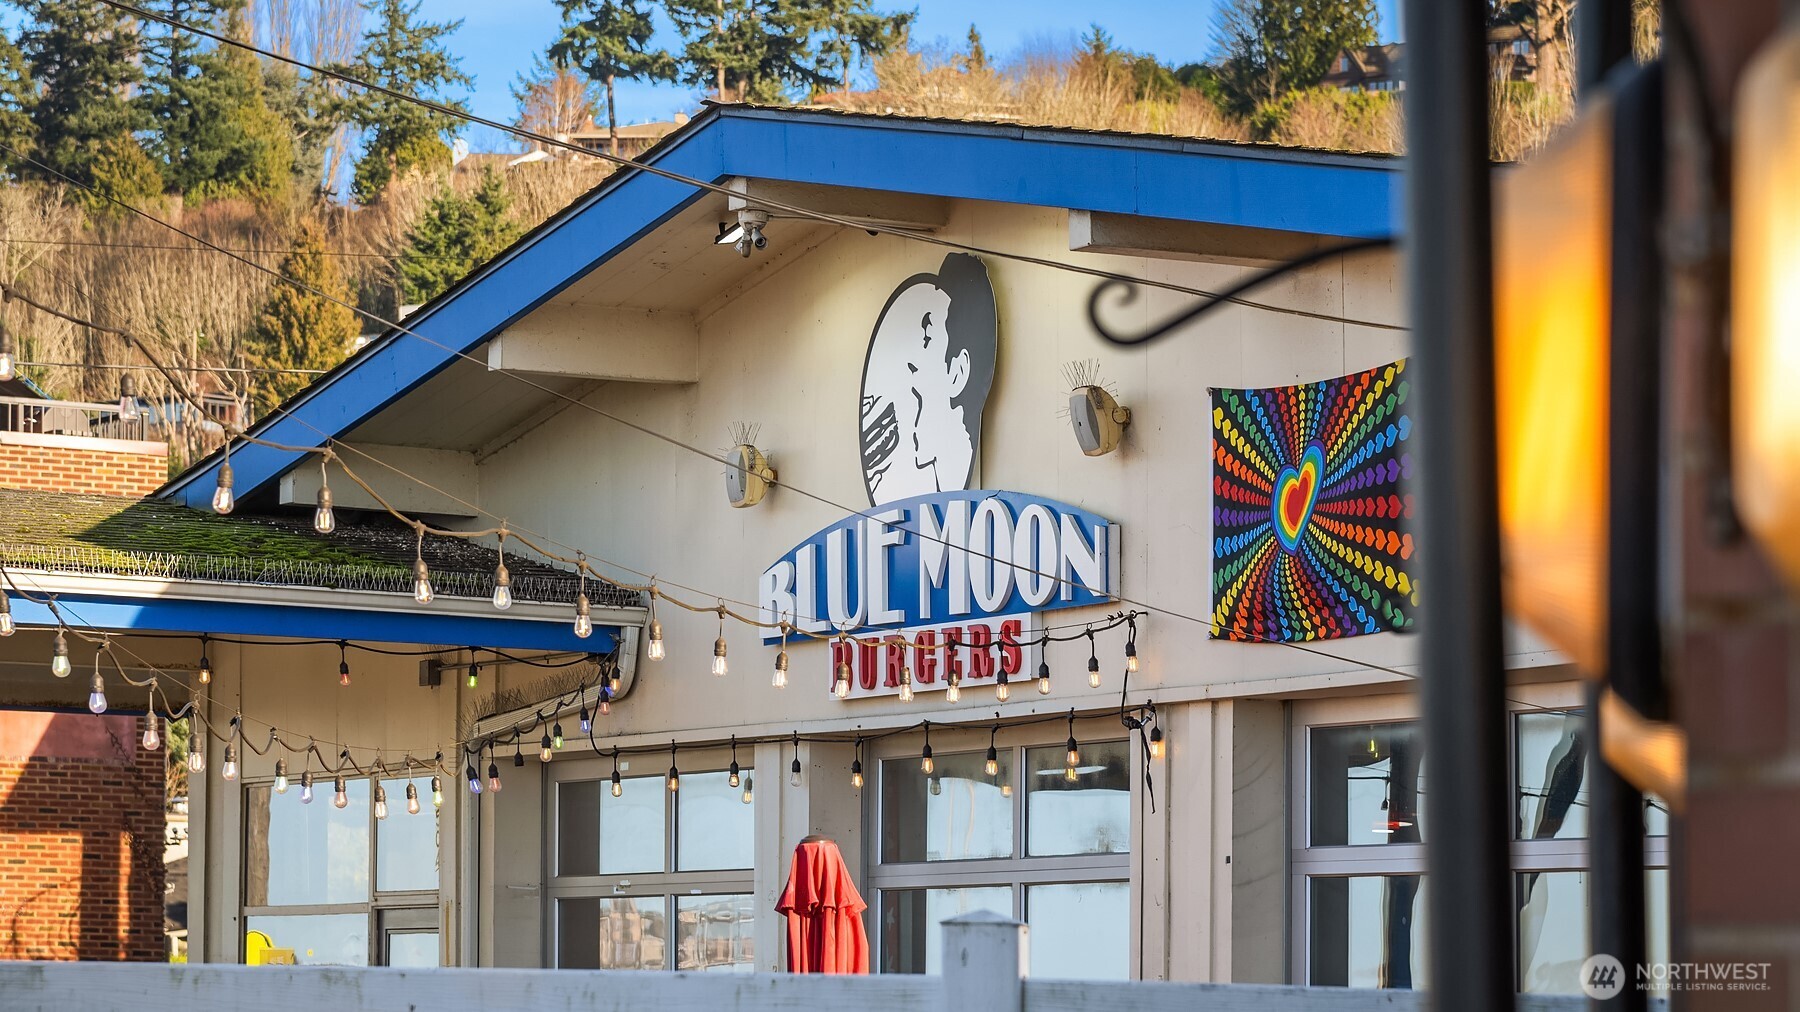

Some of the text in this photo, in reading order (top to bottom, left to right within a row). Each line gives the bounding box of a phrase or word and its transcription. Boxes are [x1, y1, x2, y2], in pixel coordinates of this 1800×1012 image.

[759, 497, 1107, 639] BLUE MOON
[830, 620, 1022, 693] BURGERS
